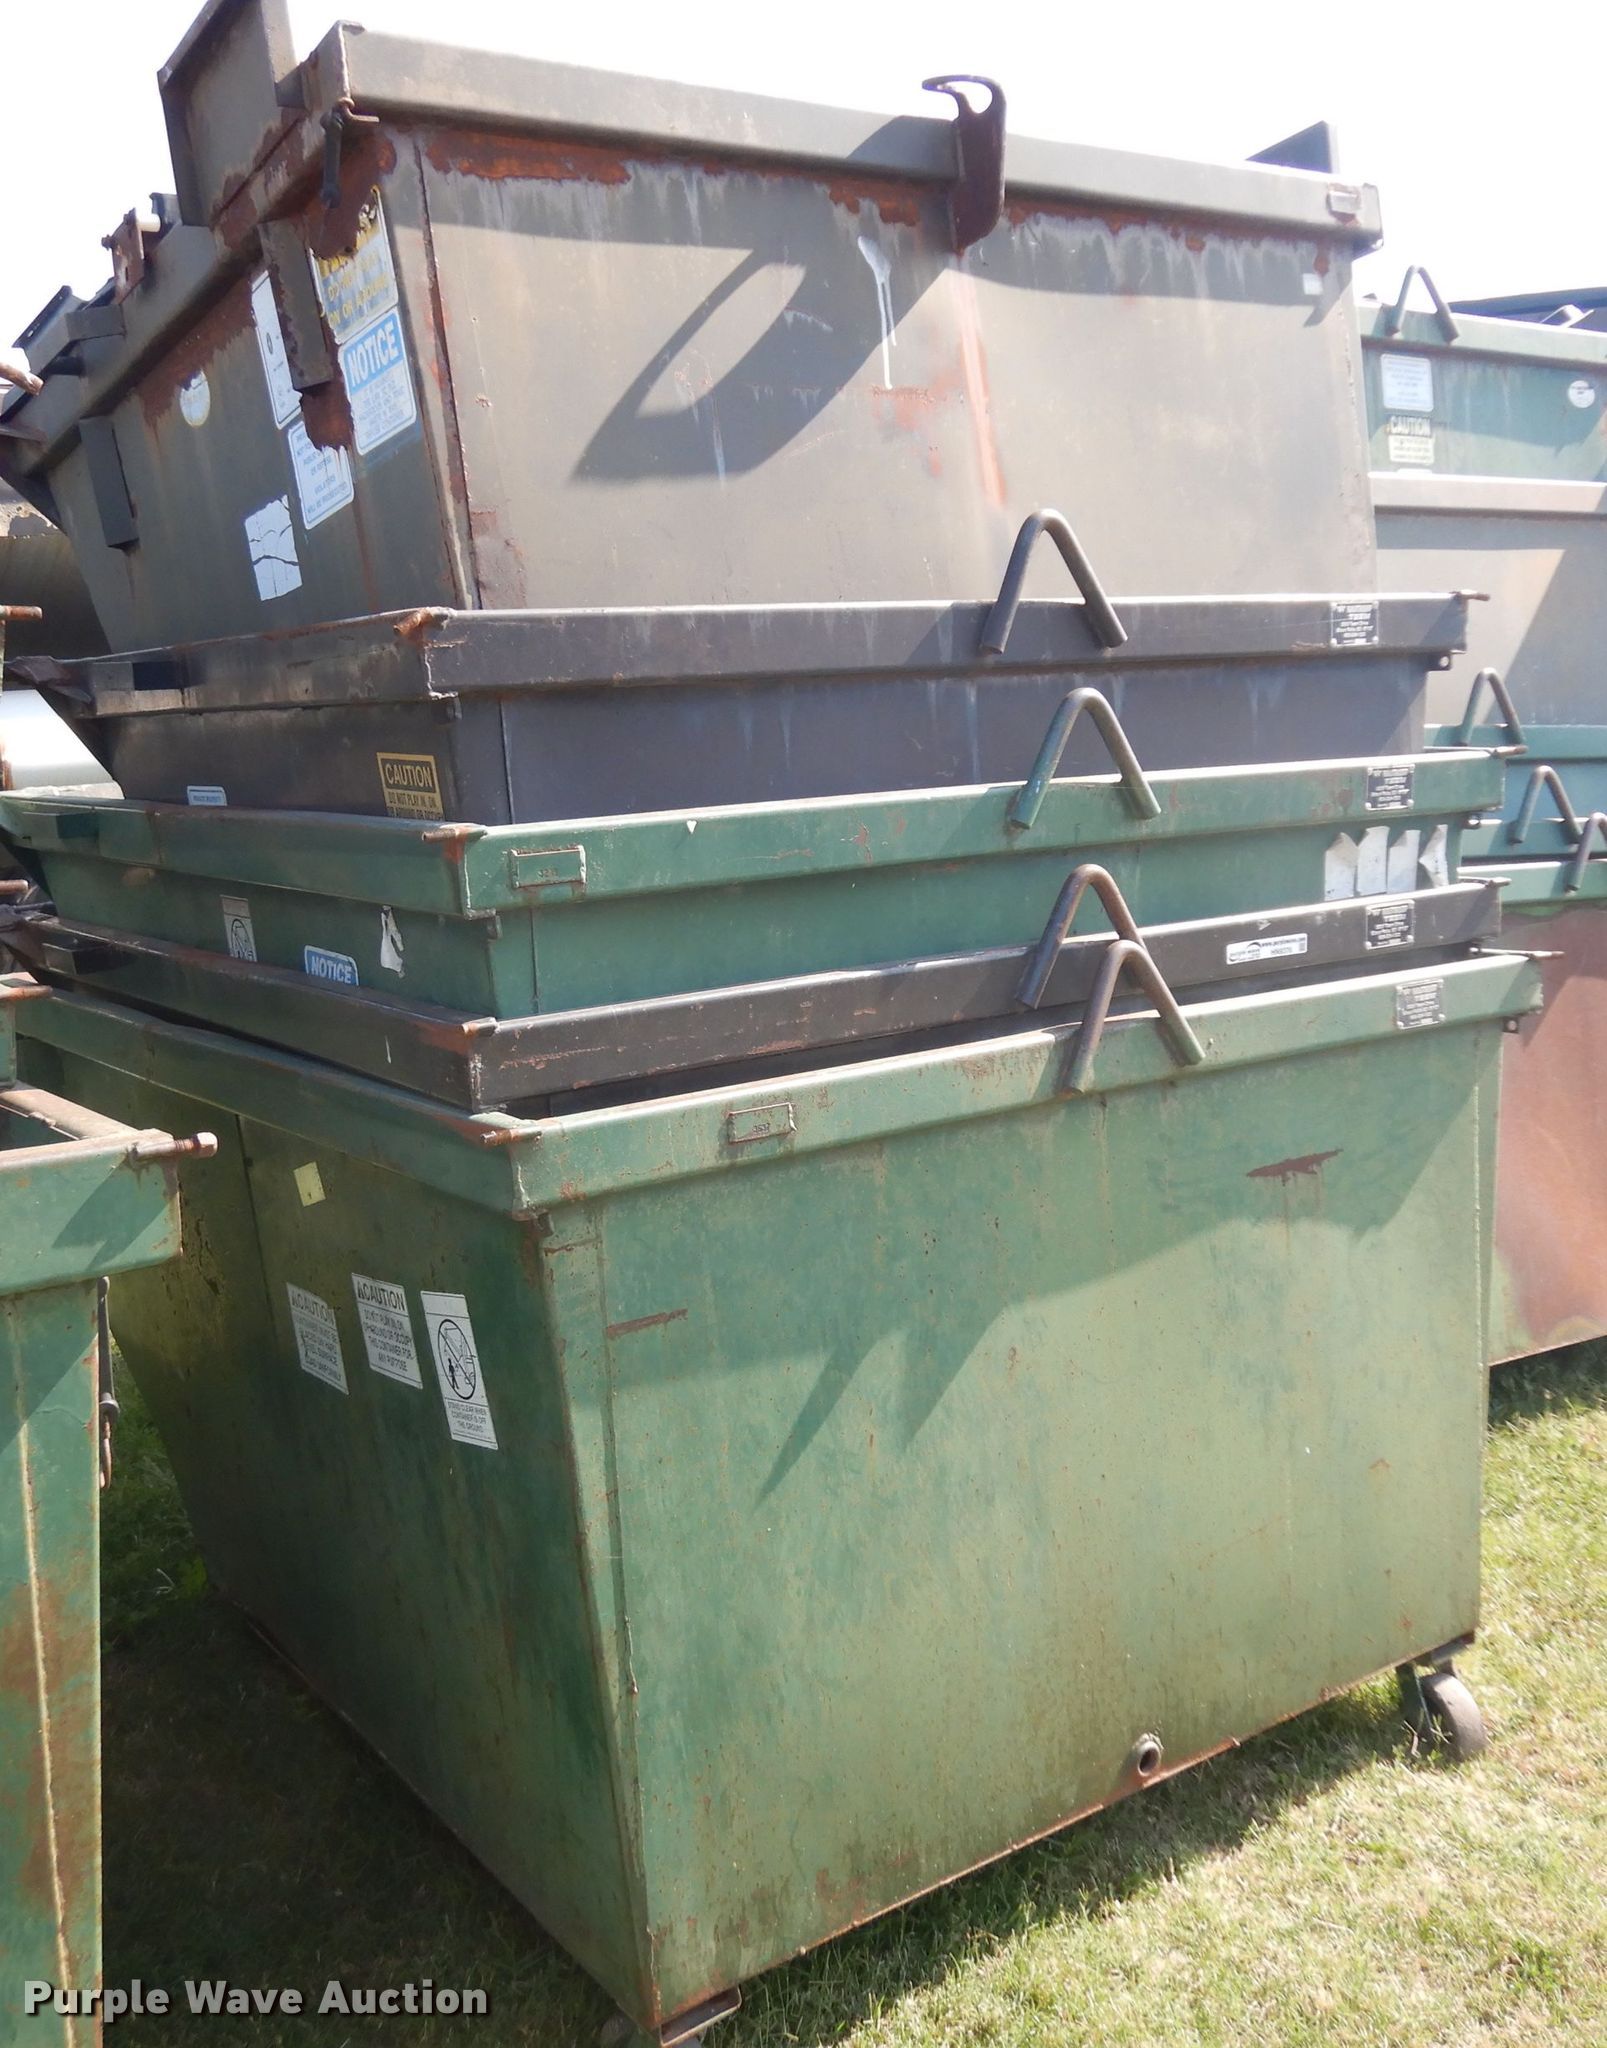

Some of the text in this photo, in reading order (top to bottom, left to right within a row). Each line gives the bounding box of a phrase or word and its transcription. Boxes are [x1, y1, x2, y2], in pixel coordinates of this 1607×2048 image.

[347, 320, 399, 387] NOTICE
[1391, 416, 1430, 435] CAUTION
[385, 763, 433, 787] CAUTION
[388, 791, 397, 804] DO
[397, 792, 407, 806] NOT
[311, 955, 352, 984] NOTICE
[298, 1293, 335, 1327] CAUTION
[363, 1283, 405, 1311] CAUTION
